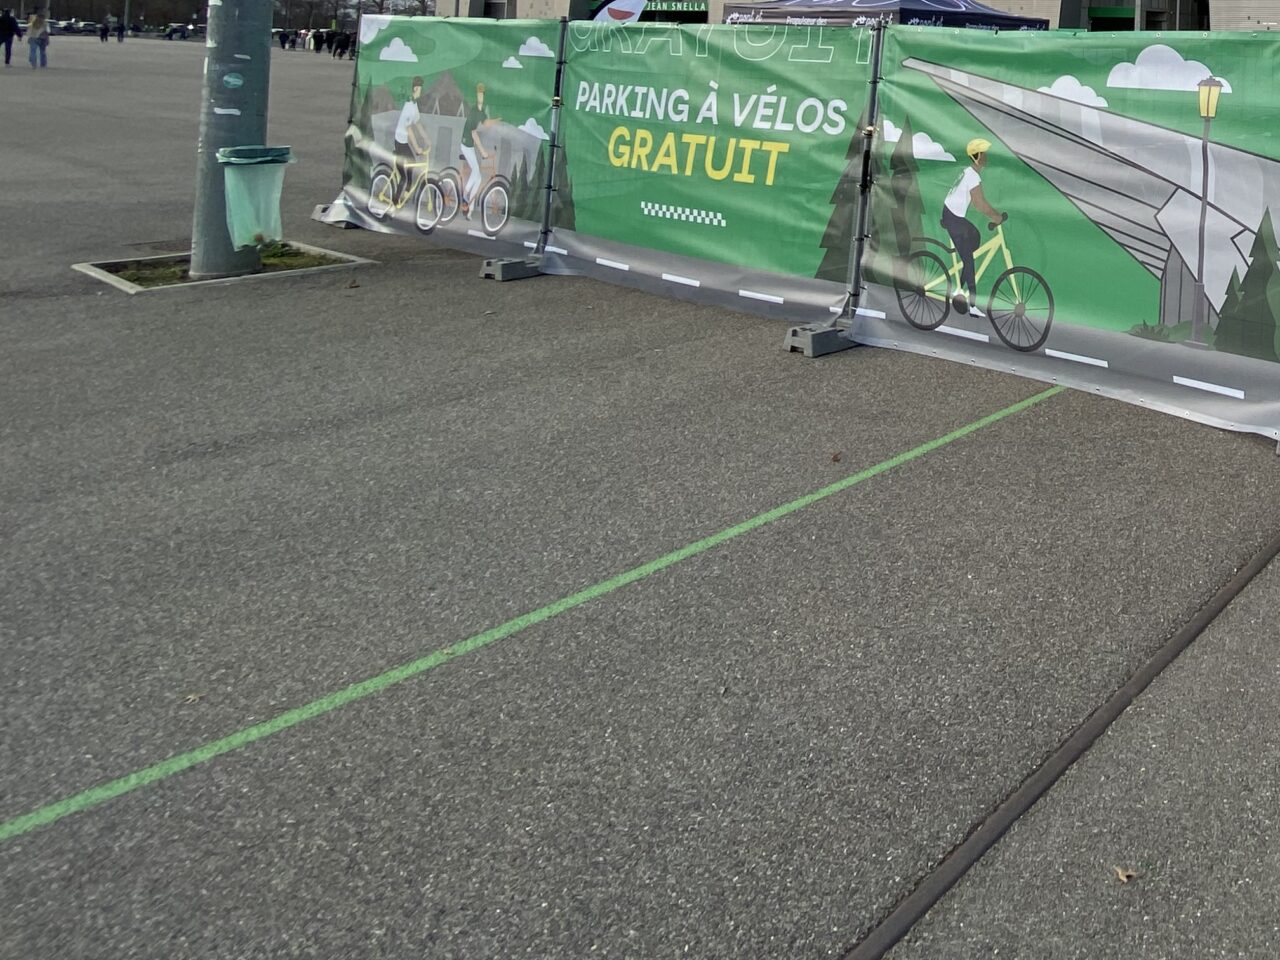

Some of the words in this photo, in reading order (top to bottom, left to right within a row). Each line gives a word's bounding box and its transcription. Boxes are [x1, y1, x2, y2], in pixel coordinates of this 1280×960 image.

[646, 2, 668, 11] JEAN
[671, 2, 706, 11] SNELLA
[575, 81, 690, 122] PARKING
[696, 80, 720, 125] À
[732, 84, 848, 136] VÉLOS
[607, 125, 791, 186] GRATUIT
